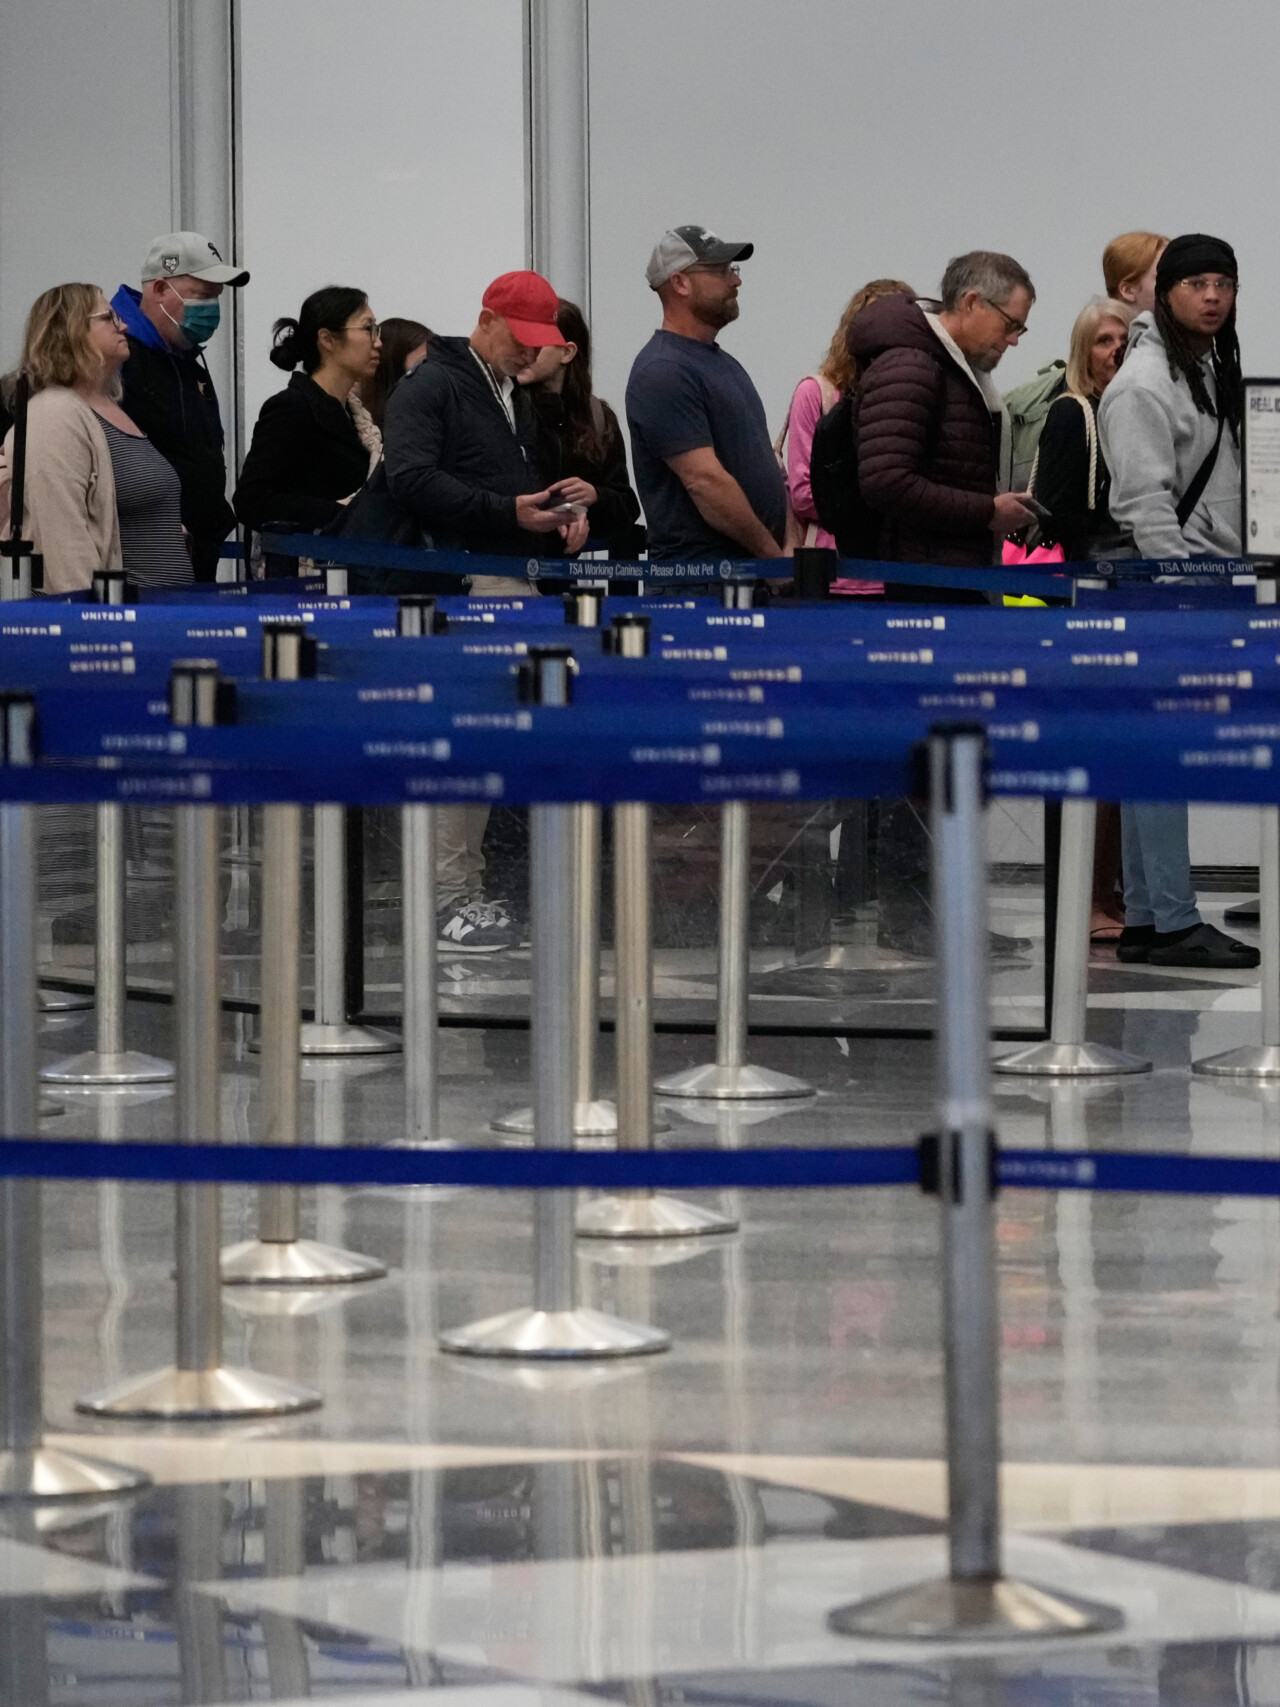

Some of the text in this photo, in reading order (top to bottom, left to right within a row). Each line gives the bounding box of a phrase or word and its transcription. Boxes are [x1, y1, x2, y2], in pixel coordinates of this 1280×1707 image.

[569, 562, 583, 575] TSA
[584, 563, 613, 578] Working
[615, 564, 643, 577] Canines
[650, 564, 673, 577] Please
[675, 564, 685, 576] Do
[687, 564, 700, 576] Not
[702, 563, 714, 575] Pet
[1157, 561, 1181, 573] TSA
[1183, 561, 1216, 575] Working
[82, 611, 123, 621] UNITED
[706, 616, 752, 626] UNITED
[886, 618, 932, 629] UNITED
[1066, 619, 1113, 630] UNITED
[661, 649, 713, 660] UNITED
[867, 652, 919, 664] UNITED
[1071, 654, 1124, 666] UNITED
